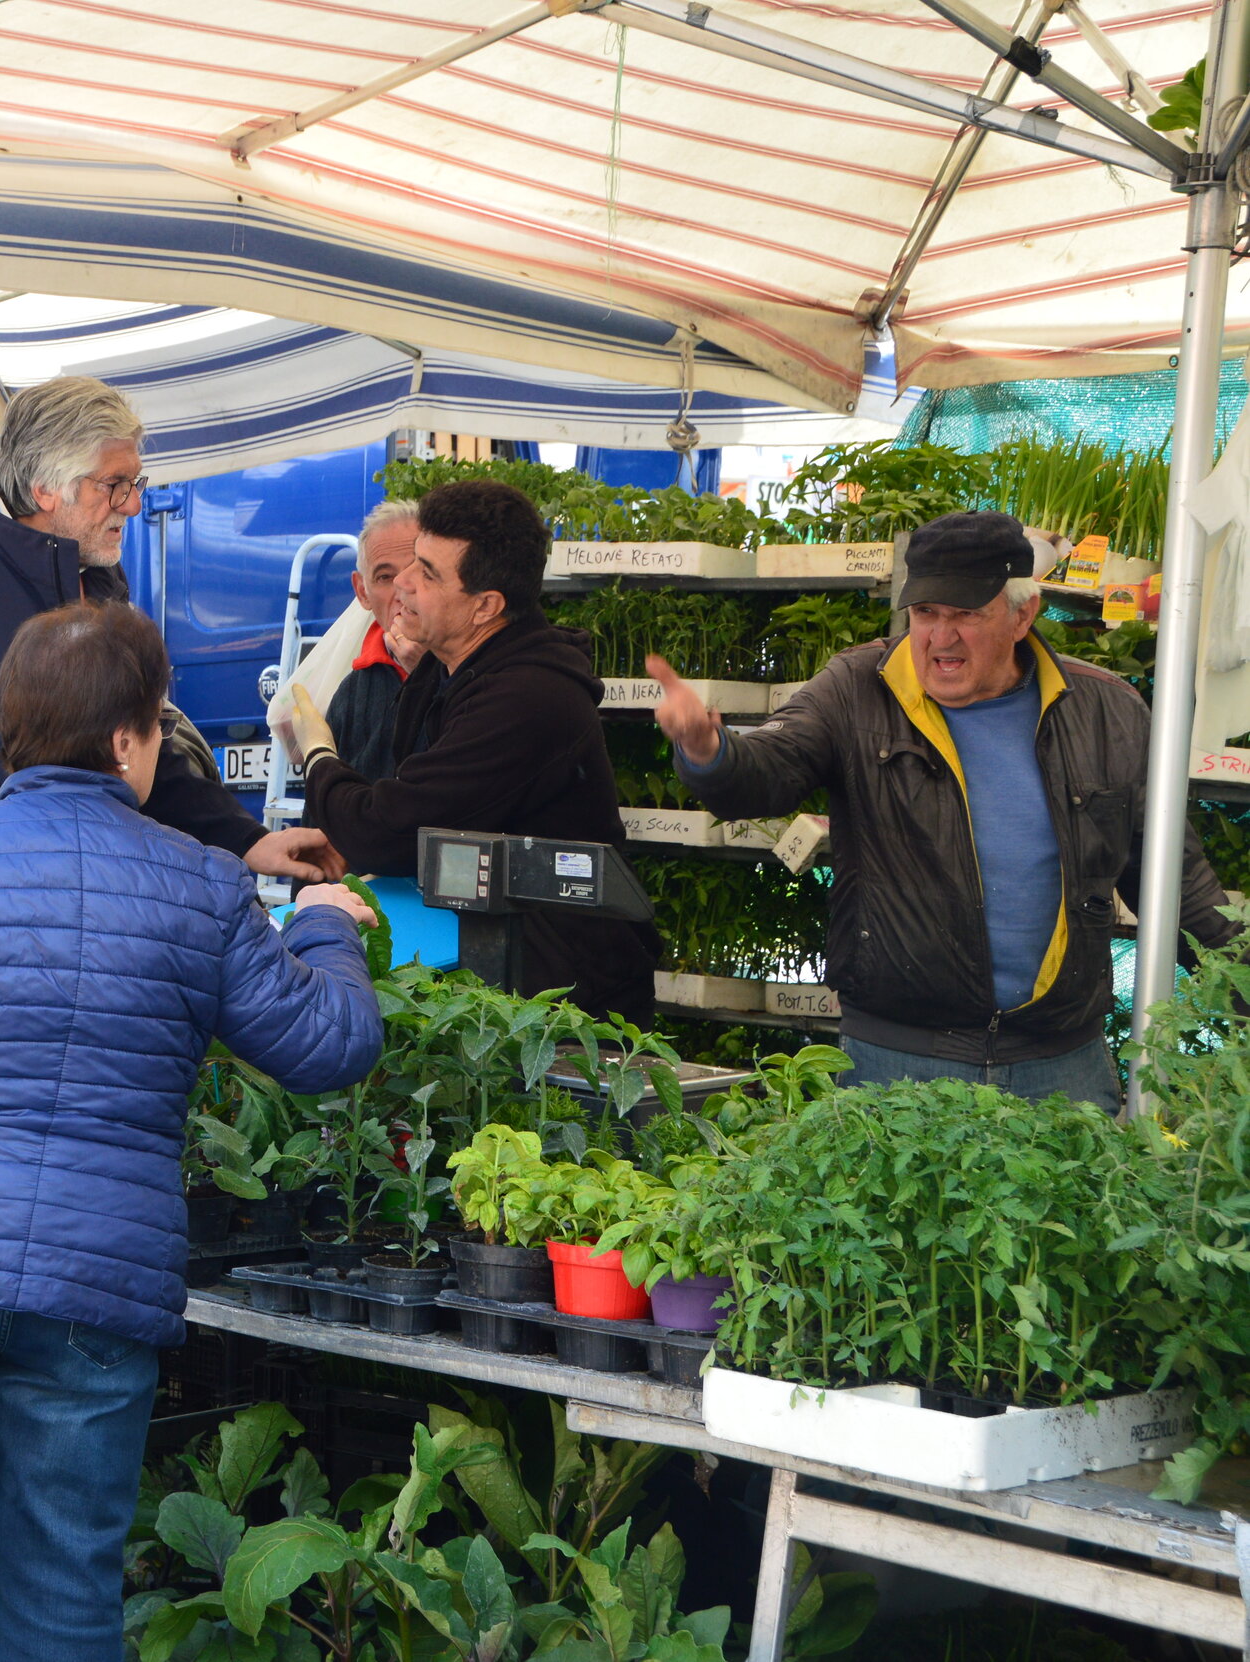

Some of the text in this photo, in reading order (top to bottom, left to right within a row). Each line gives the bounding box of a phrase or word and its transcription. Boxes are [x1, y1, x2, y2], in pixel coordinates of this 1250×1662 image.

[566, 547, 683, 568] MELONE RETATO
[262, 680, 279, 695] FIA
[632, 683, 662, 700] NERA
[227, 748, 253, 780] DE
